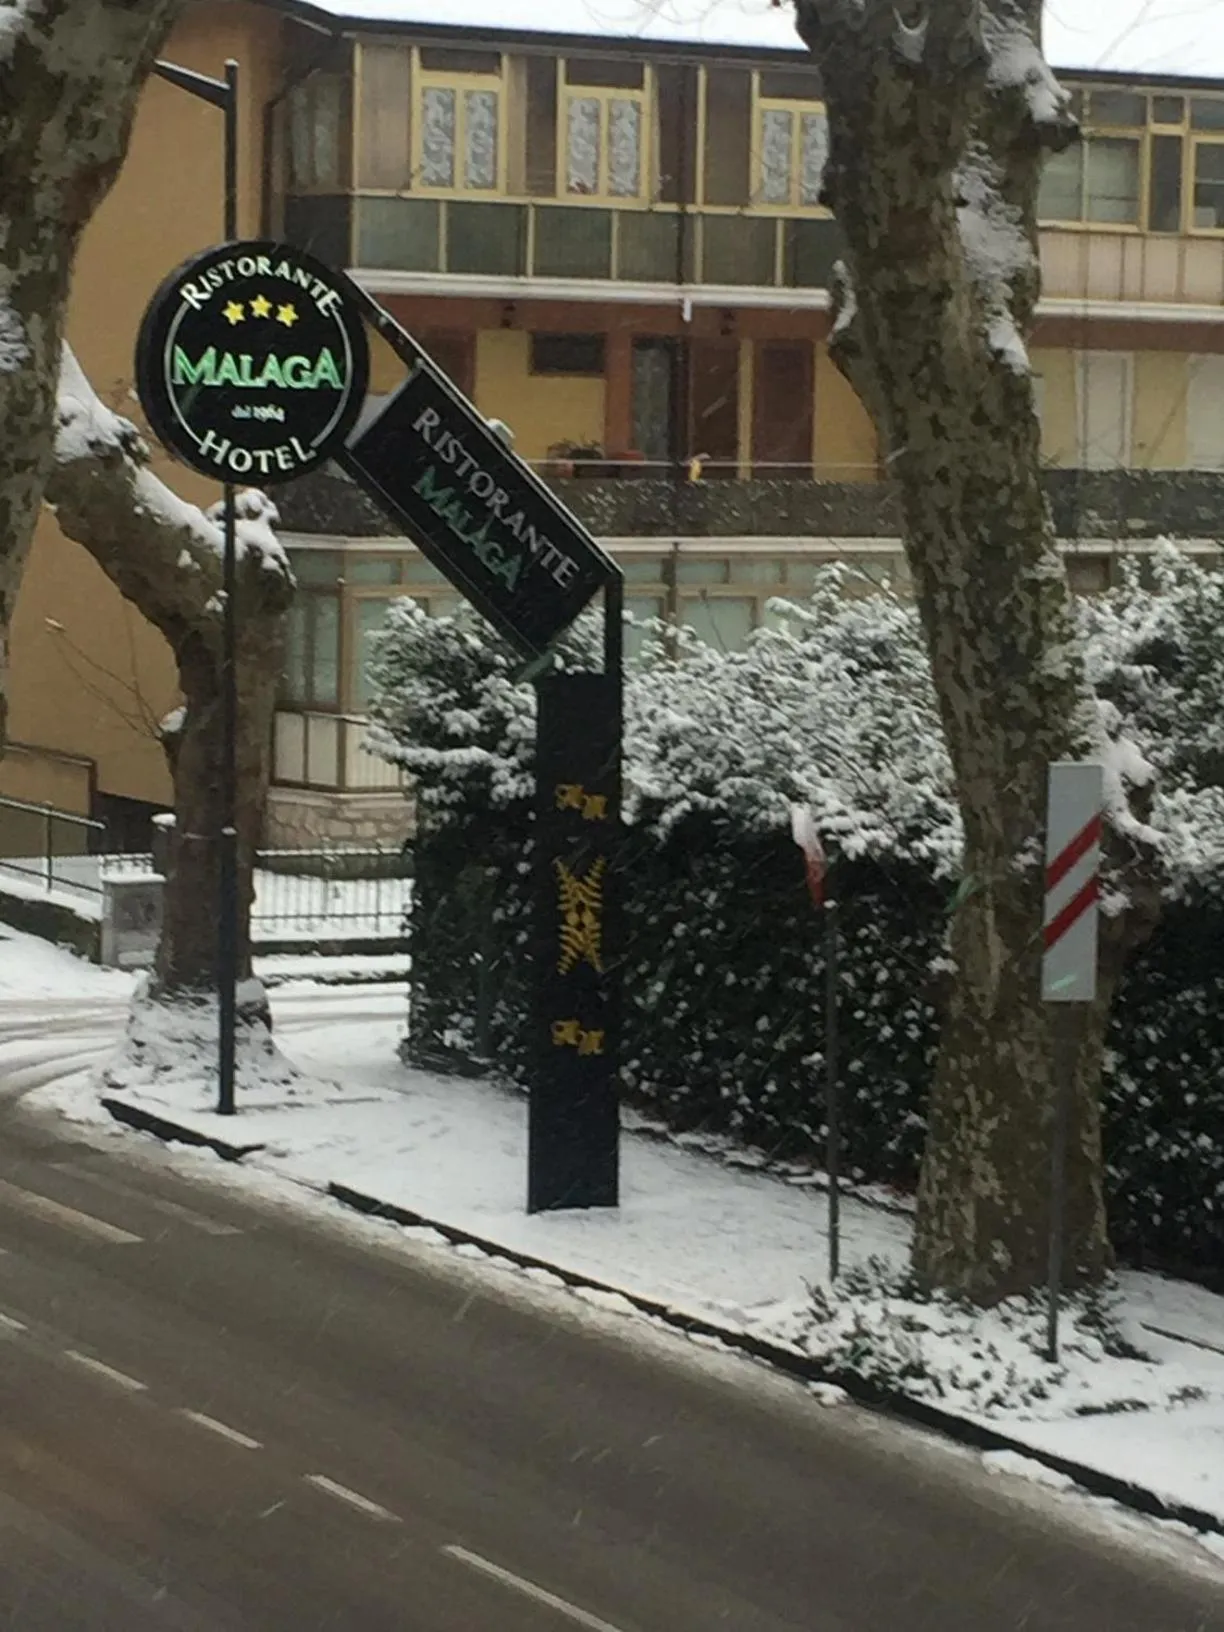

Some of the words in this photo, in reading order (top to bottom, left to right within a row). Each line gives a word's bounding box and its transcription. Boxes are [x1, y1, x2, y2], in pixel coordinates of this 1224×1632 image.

[179, 255, 343, 317] RISTORANTE
[171, 344, 345, 390] MALAGA
[199, 429, 317, 473] HOTEL
[411, 407, 580, 588] RISTORANTE
[412, 465, 522, 592] MALAGA
